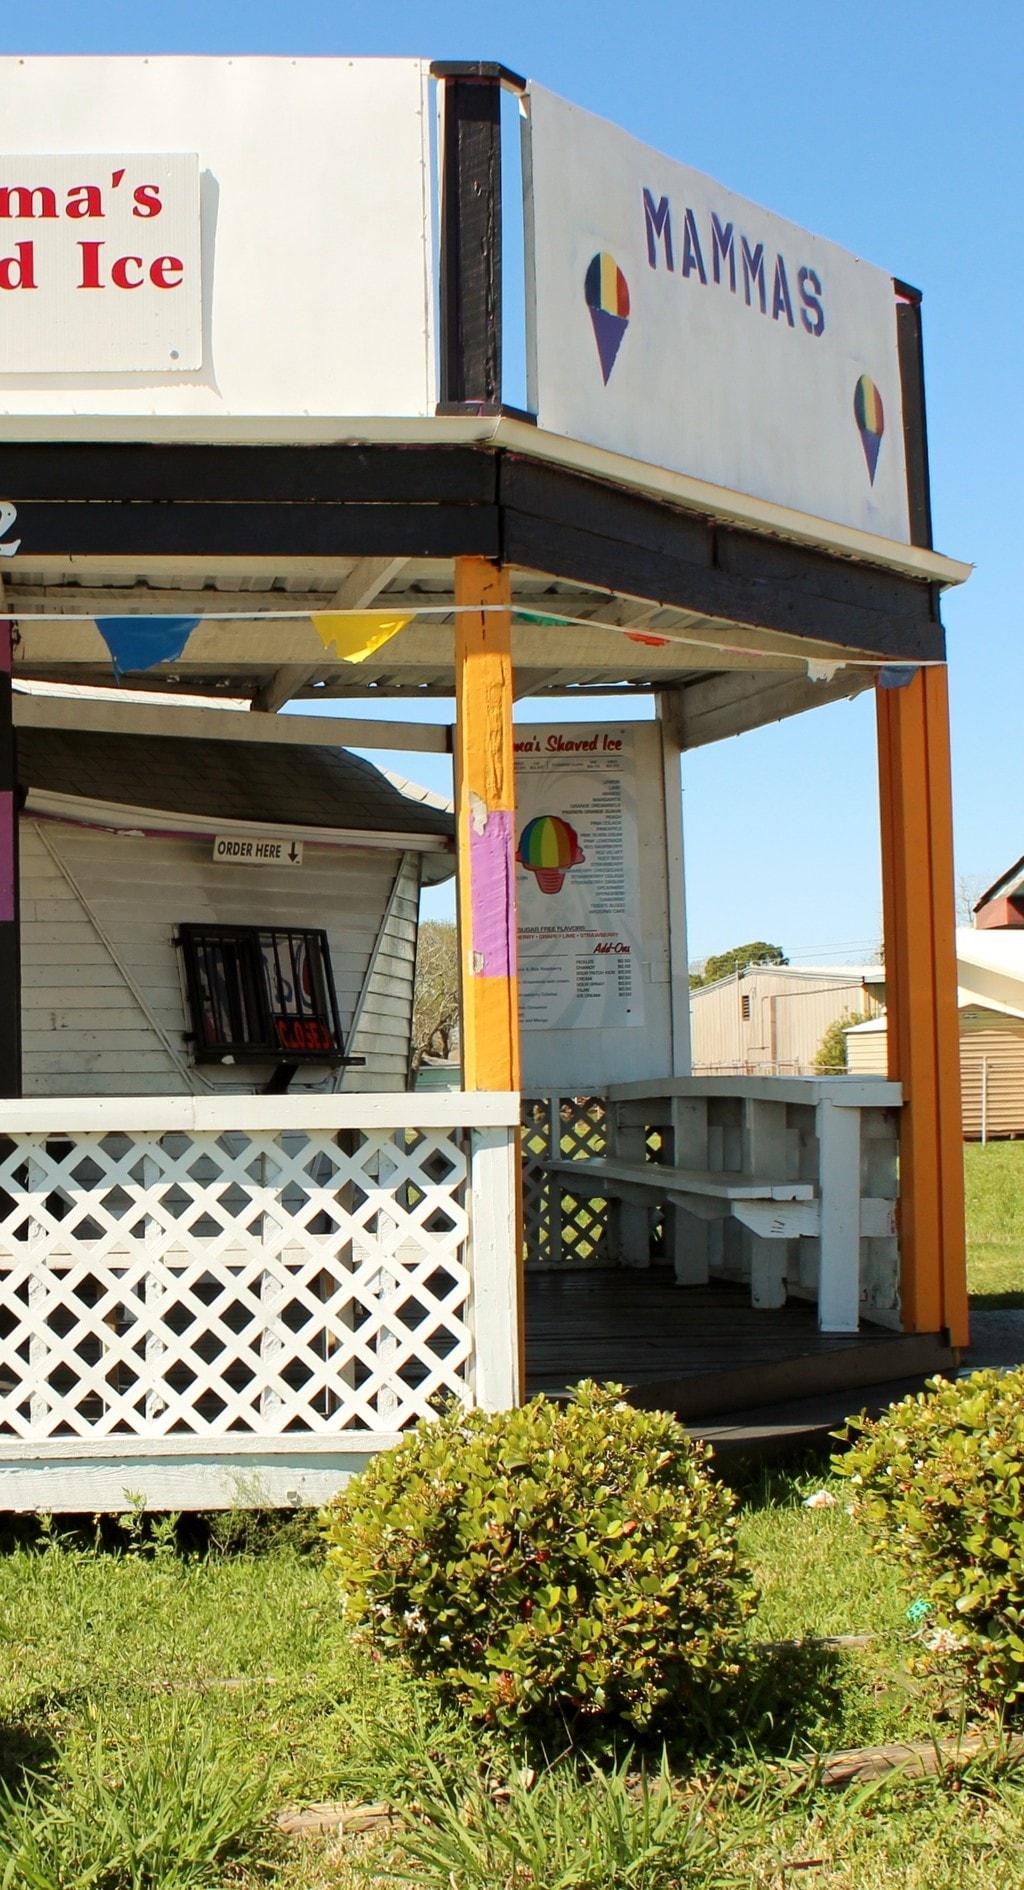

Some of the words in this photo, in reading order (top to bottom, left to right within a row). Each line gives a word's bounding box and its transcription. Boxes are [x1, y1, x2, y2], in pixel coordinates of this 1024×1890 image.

[77, 241, 185, 290] Ice
[642, 187, 825, 338] MAMMAS
[544, 734, 599, 753] Shaved
[603, 733, 623, 751] Ice
[217, 840, 252, 857] ORDER
[255, 843, 281, 859] HERE
[593, 941, 632, 954] Add-Ons
